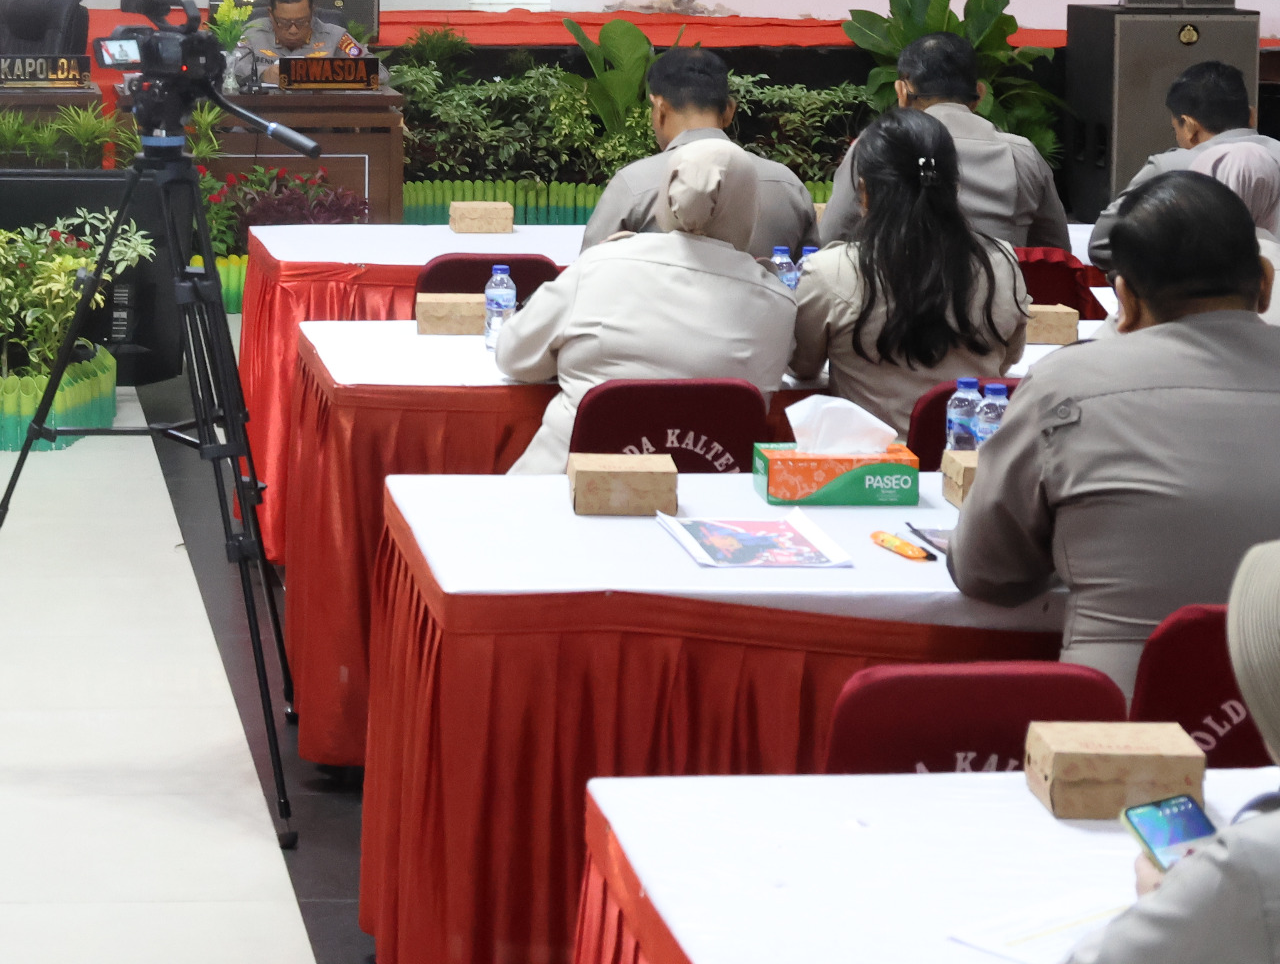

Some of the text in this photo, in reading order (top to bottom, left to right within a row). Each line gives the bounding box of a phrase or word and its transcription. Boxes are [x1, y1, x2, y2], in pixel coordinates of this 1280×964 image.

[0, 57, 80, 79] KAPOLDA
[290, 59, 368, 81] IRWASDA
[665, 428, 741, 473] KALTE
[865, 474, 912, 489] PASEO
